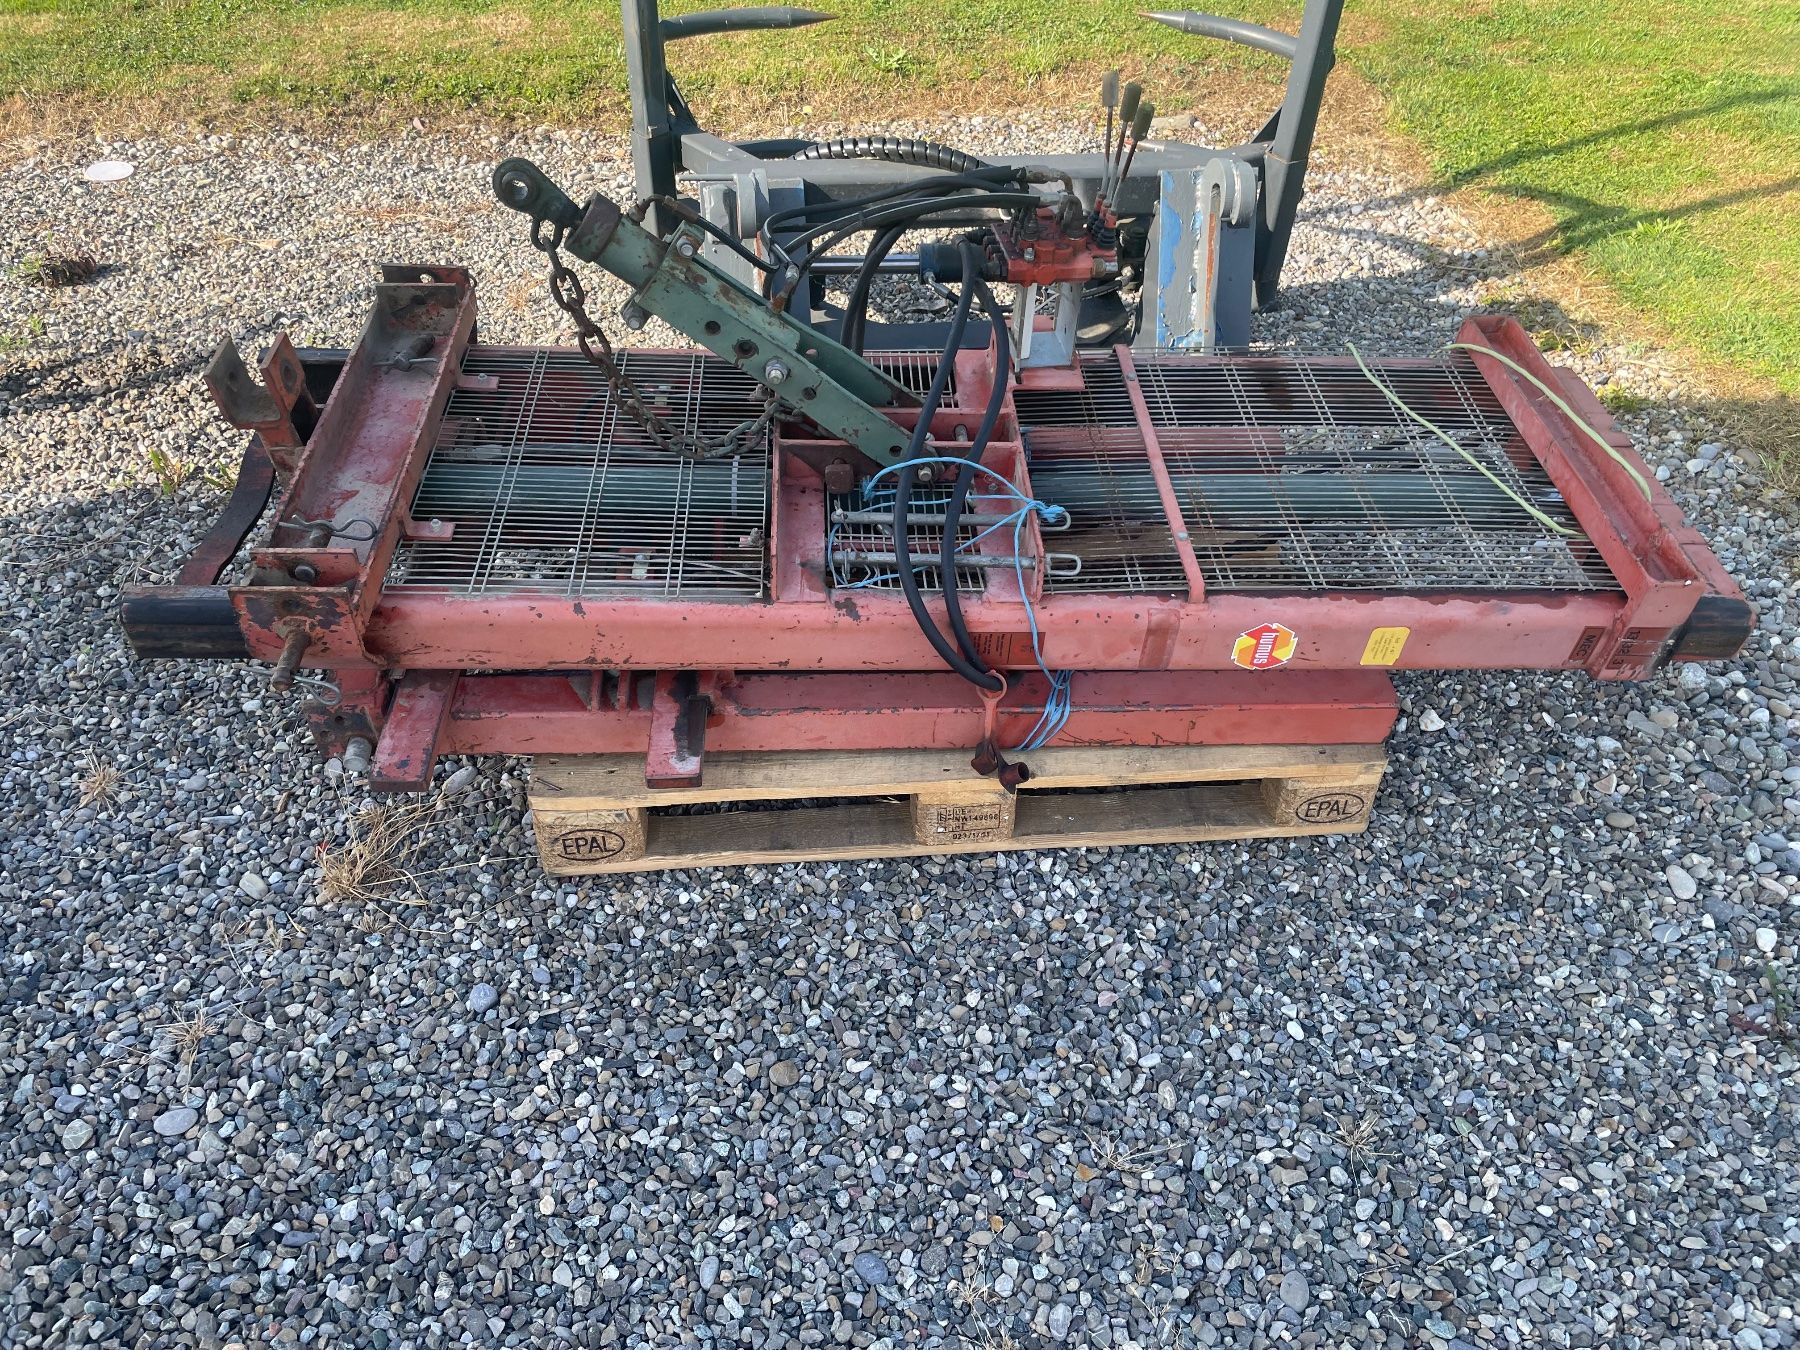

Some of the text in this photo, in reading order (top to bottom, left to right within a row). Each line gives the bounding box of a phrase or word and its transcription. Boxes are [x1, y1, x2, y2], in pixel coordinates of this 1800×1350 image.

[1253, 632, 1280, 664] humus
[1304, 799, 1352, 818] EPAL
[561, 835, 616, 855] EPAL
